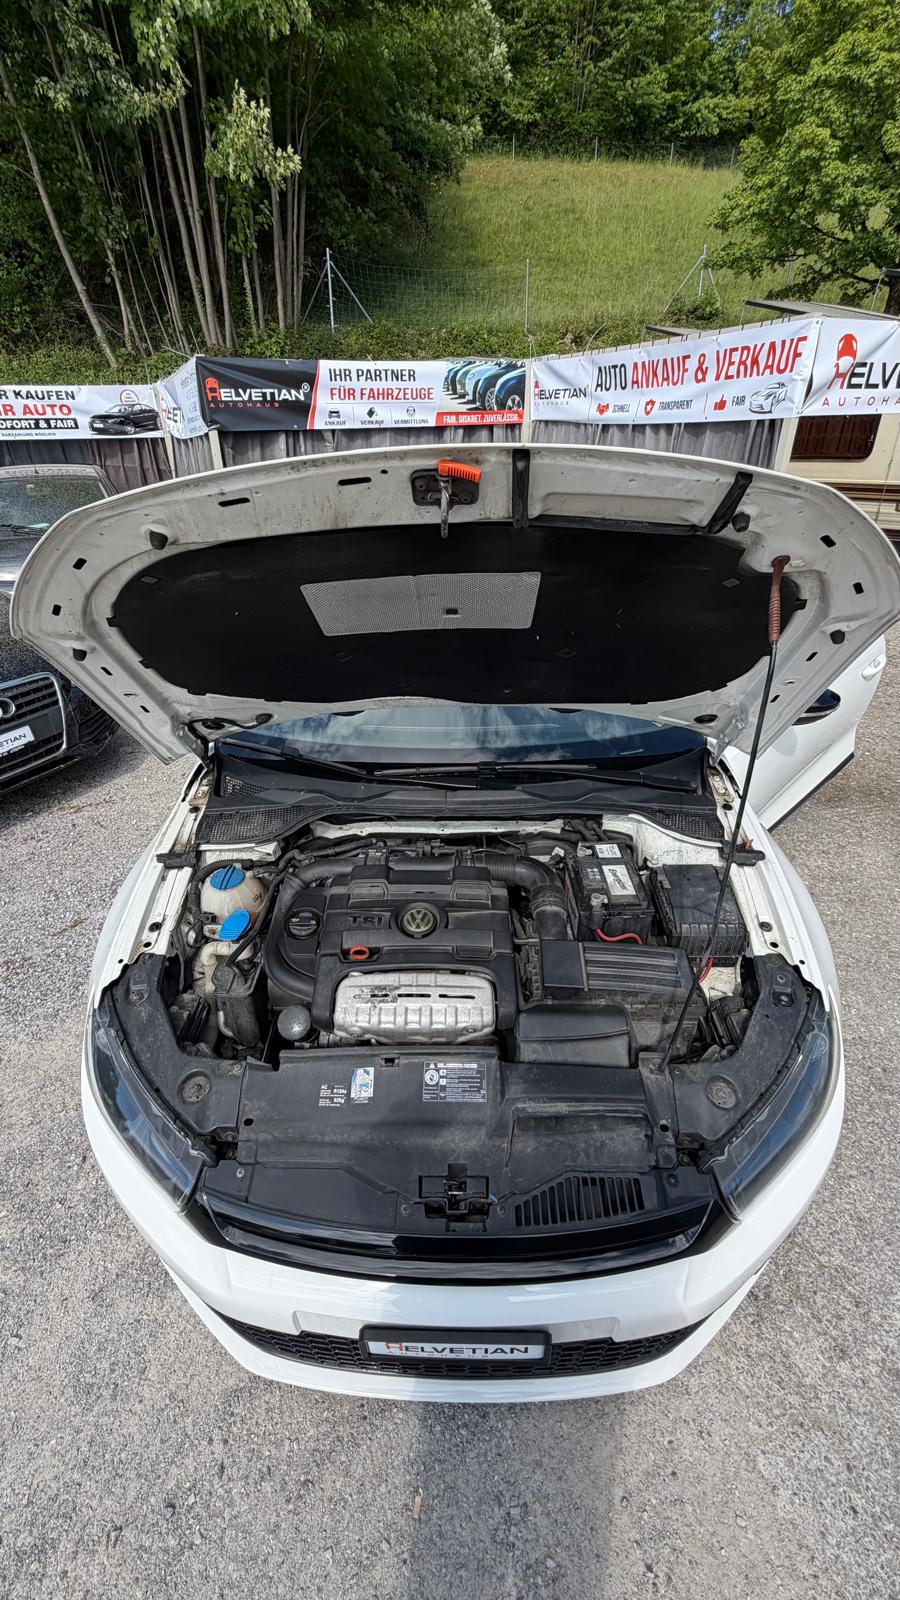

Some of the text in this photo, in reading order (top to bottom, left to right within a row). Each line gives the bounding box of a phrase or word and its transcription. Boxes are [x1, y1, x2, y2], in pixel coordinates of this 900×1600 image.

[595, 335, 808, 392] AUTO ANKAUF & VERKAUF
[827, 334, 900, 389] HELV
[328, 368, 416, 382] IHR PARTNER
[0, 389, 76, 400] R KAUFEN
[330, 385, 434, 401] FÜR FAHRZEUGE
[533, 380, 587, 400] HELVETIAN
[658, 399, 694, 411] TRANSPARENT
[731, 395, 746, 407] FAIR
[0, 403, 72, 416] R AUTO
[611, 404, 631, 413] SCHNELL
[0, 419, 76, 429] OFORT & FAIR
[384, 1341, 529, 1355] HELVETIAN
